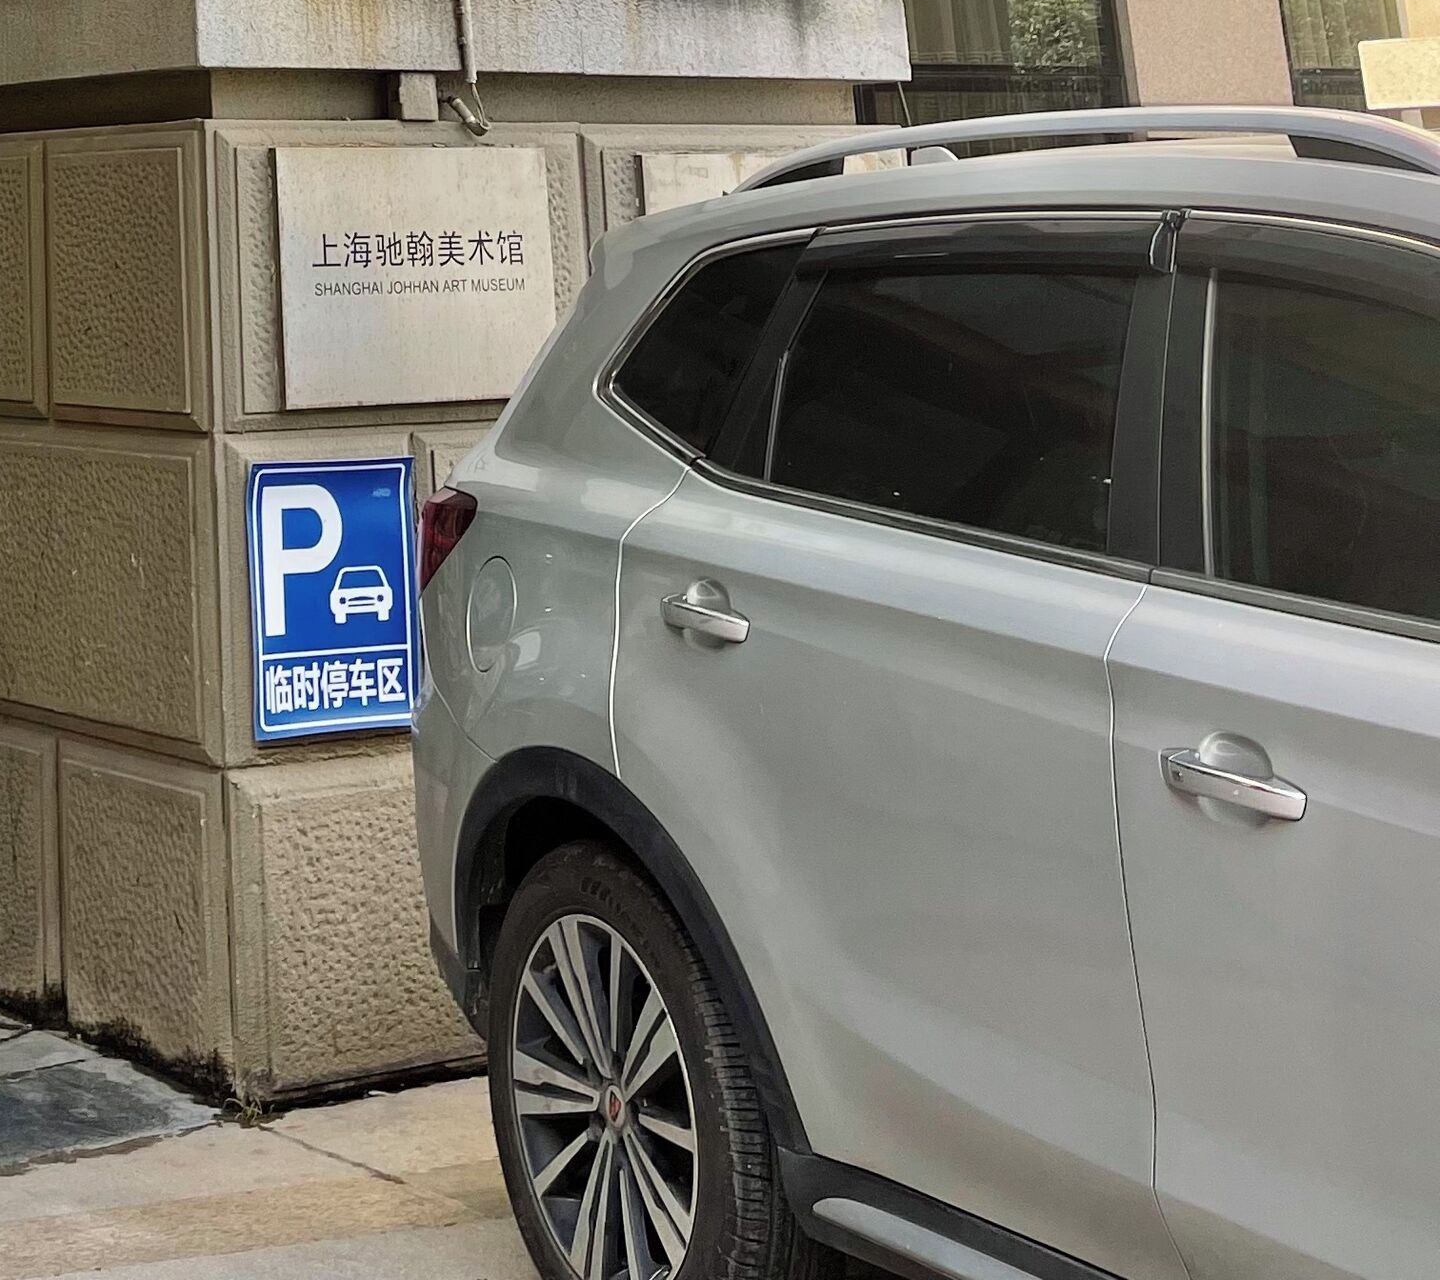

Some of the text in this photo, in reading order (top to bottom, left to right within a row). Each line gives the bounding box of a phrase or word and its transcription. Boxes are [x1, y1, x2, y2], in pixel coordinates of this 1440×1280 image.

[312, 229, 524, 269] 上海驰翰美术馆
[314, 277, 525, 297] SHANGHAI JOHHAN ART MUSEUM
[260, 483, 343, 638] P
[264, 656, 407, 716] 临时停车区
